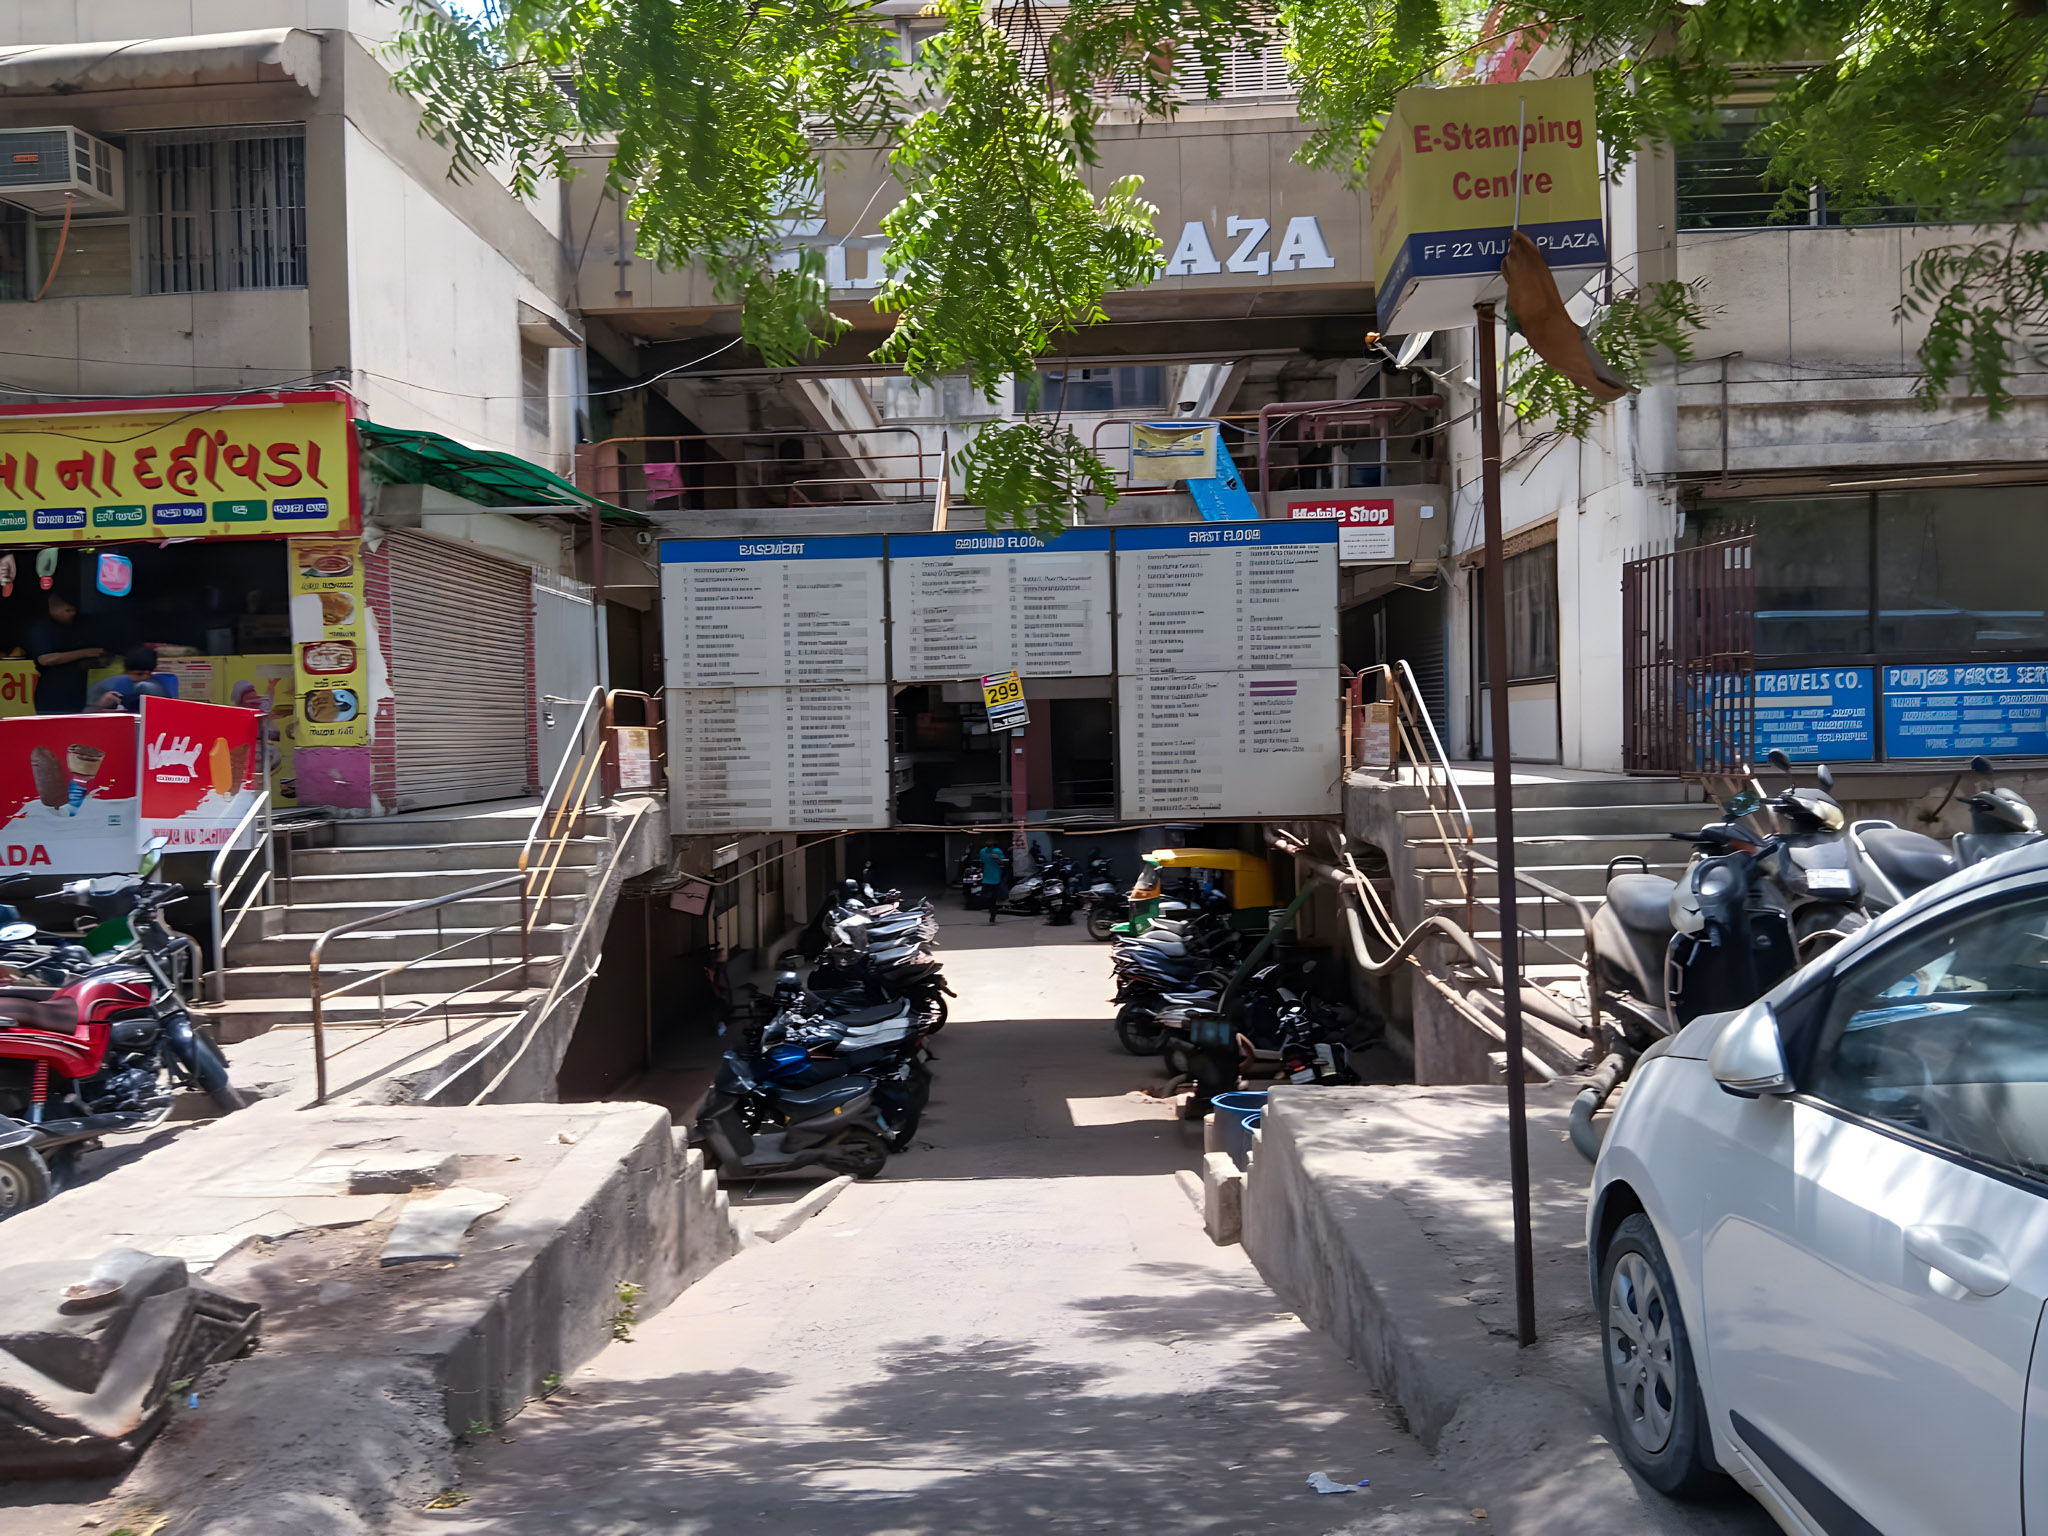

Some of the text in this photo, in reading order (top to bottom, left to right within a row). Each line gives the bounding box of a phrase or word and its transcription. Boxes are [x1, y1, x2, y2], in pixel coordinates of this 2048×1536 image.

[1413, 116, 1583, 153] E-Stamping
[1453, 168, 1553, 200] Centre
[1152, 215, 1336, 281] AZA
[1424, 244, 1447, 261] FF
[1452, 243, 1473, 258] 22
[1537, 232, 1600, 250] PLAZA
[1349, 505, 1389, 525] Shop
[987, 682, 1019, 704] 299
[1754, 672, 1830, 692] TRAVELS
[1834, 671, 1863, 689] CO.
